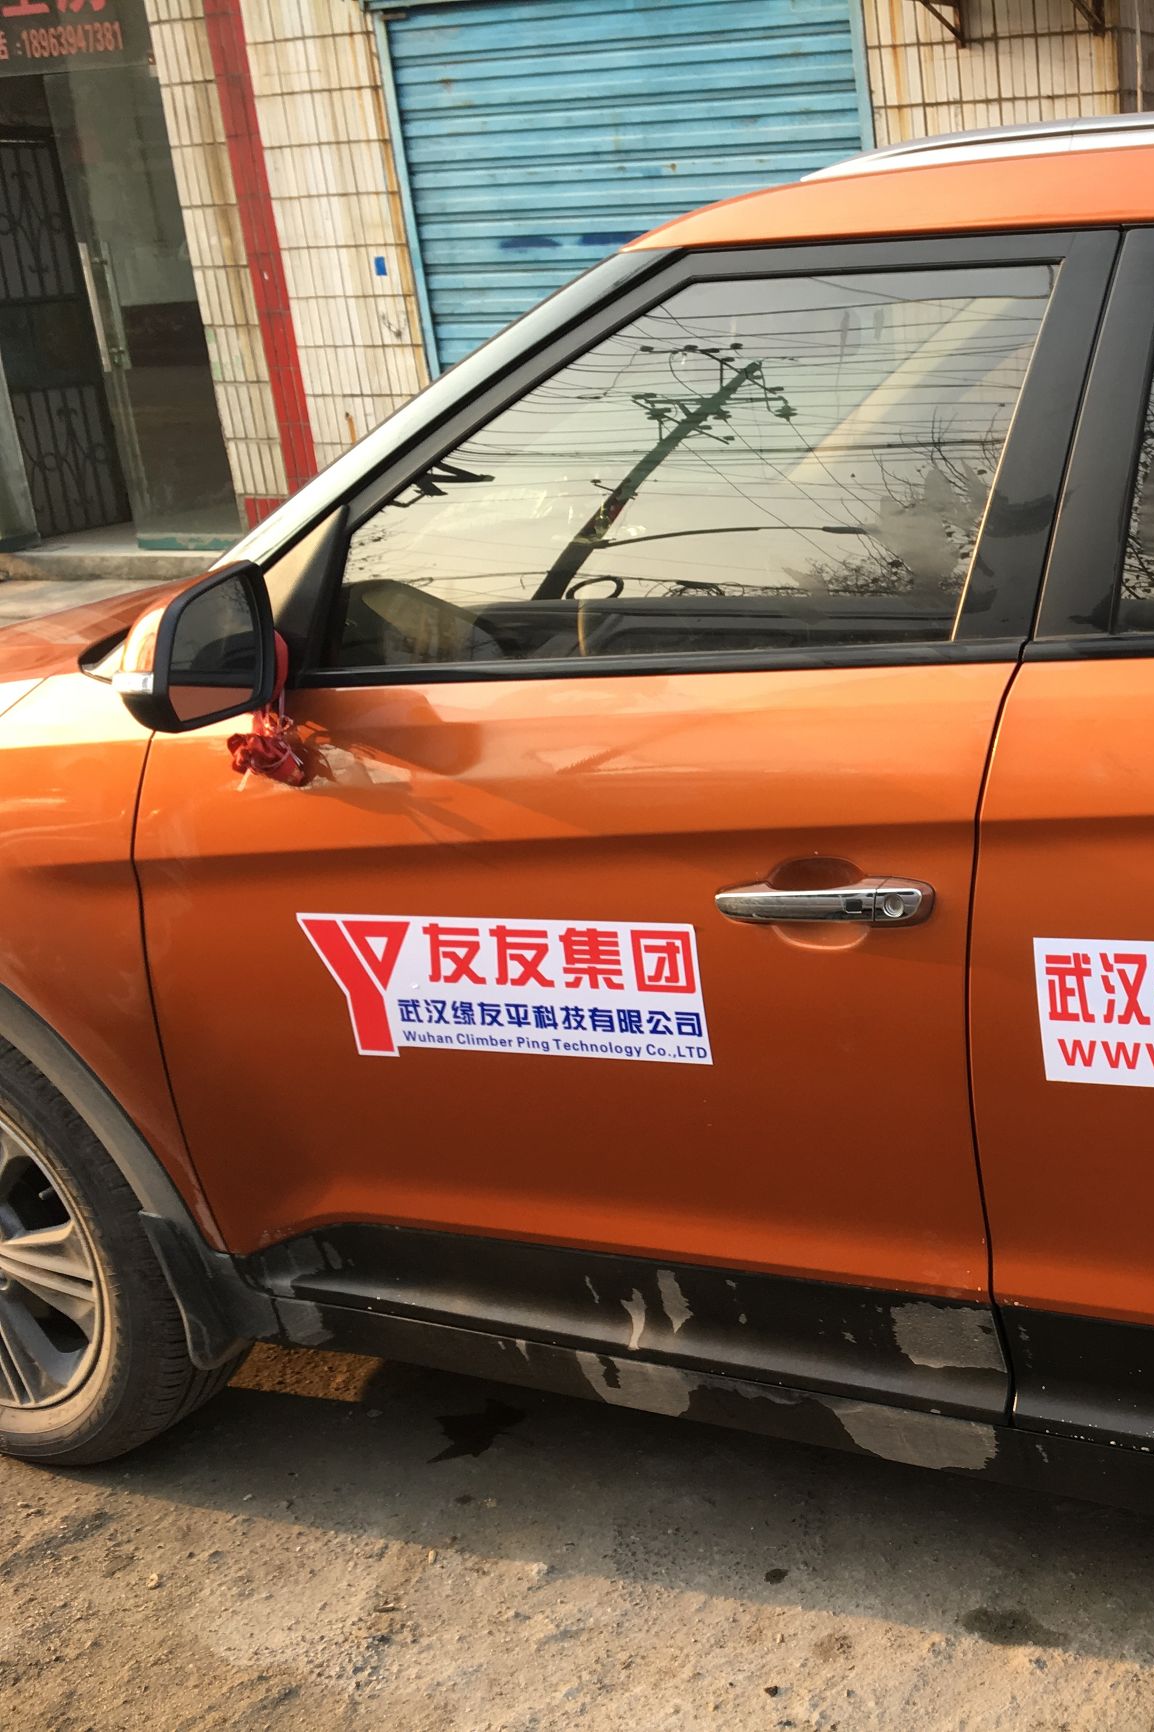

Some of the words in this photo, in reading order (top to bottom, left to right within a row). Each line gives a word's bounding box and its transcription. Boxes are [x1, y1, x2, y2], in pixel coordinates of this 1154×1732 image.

[422, 923, 697, 994] 友友集团
[398, 999, 704, 1038] 武汉缘友平科技有限公司
[403, 1030, 453, 1045] Wuhan
[457, 1033, 513, 1048] Climber
[517, 1036, 550, 1052] Ping
[552, 1038, 642, 1057] Technology
[646, 1044, 708, 1059] Co.,LTD
